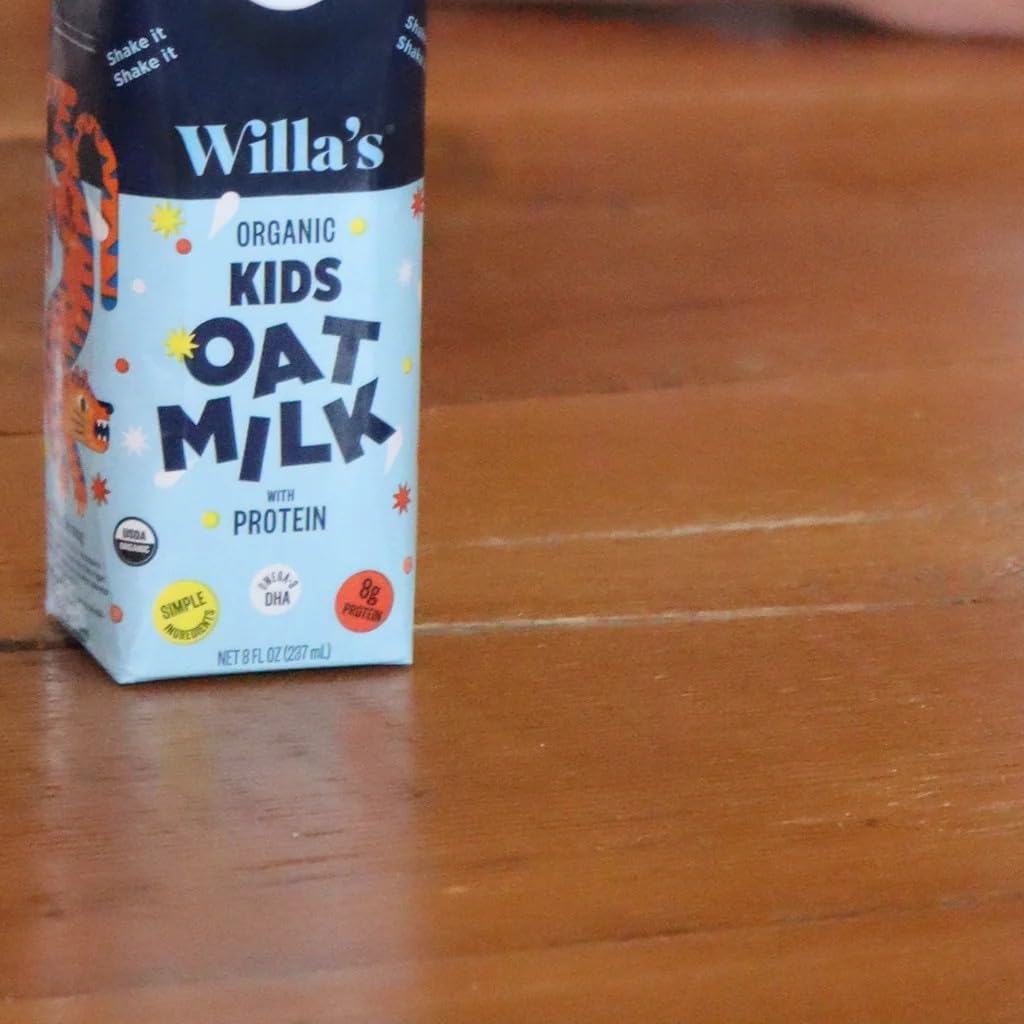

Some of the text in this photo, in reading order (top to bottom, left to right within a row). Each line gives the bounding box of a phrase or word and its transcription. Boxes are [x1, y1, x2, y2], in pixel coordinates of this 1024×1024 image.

[106, 27, 167, 66] Shake it
[113, 47, 178, 87] Shake it
[175, 116, 384, 176] Willa's
[236, 217, 336, 247] ORGANIC
[229, 257, 342, 306] KIDS
[183, 315, 381, 399] OAT
[156, 376, 397, 483] MILK
[267, 488, 295, 503] WITH
[122, 527, 146, 541] USDA
[233, 505, 326, 535] PROTEIN
[159, 591, 208, 620] SIMPLE
[264, 591, 290, 607] DHA
[359, 577, 381, 606] 8g
[164, 609, 215, 640] INGREDIENTS
[342, 603, 383, 622] PROTEIN
[217, 642, 331, 666] NET 8 FL OZ (237 mL)
